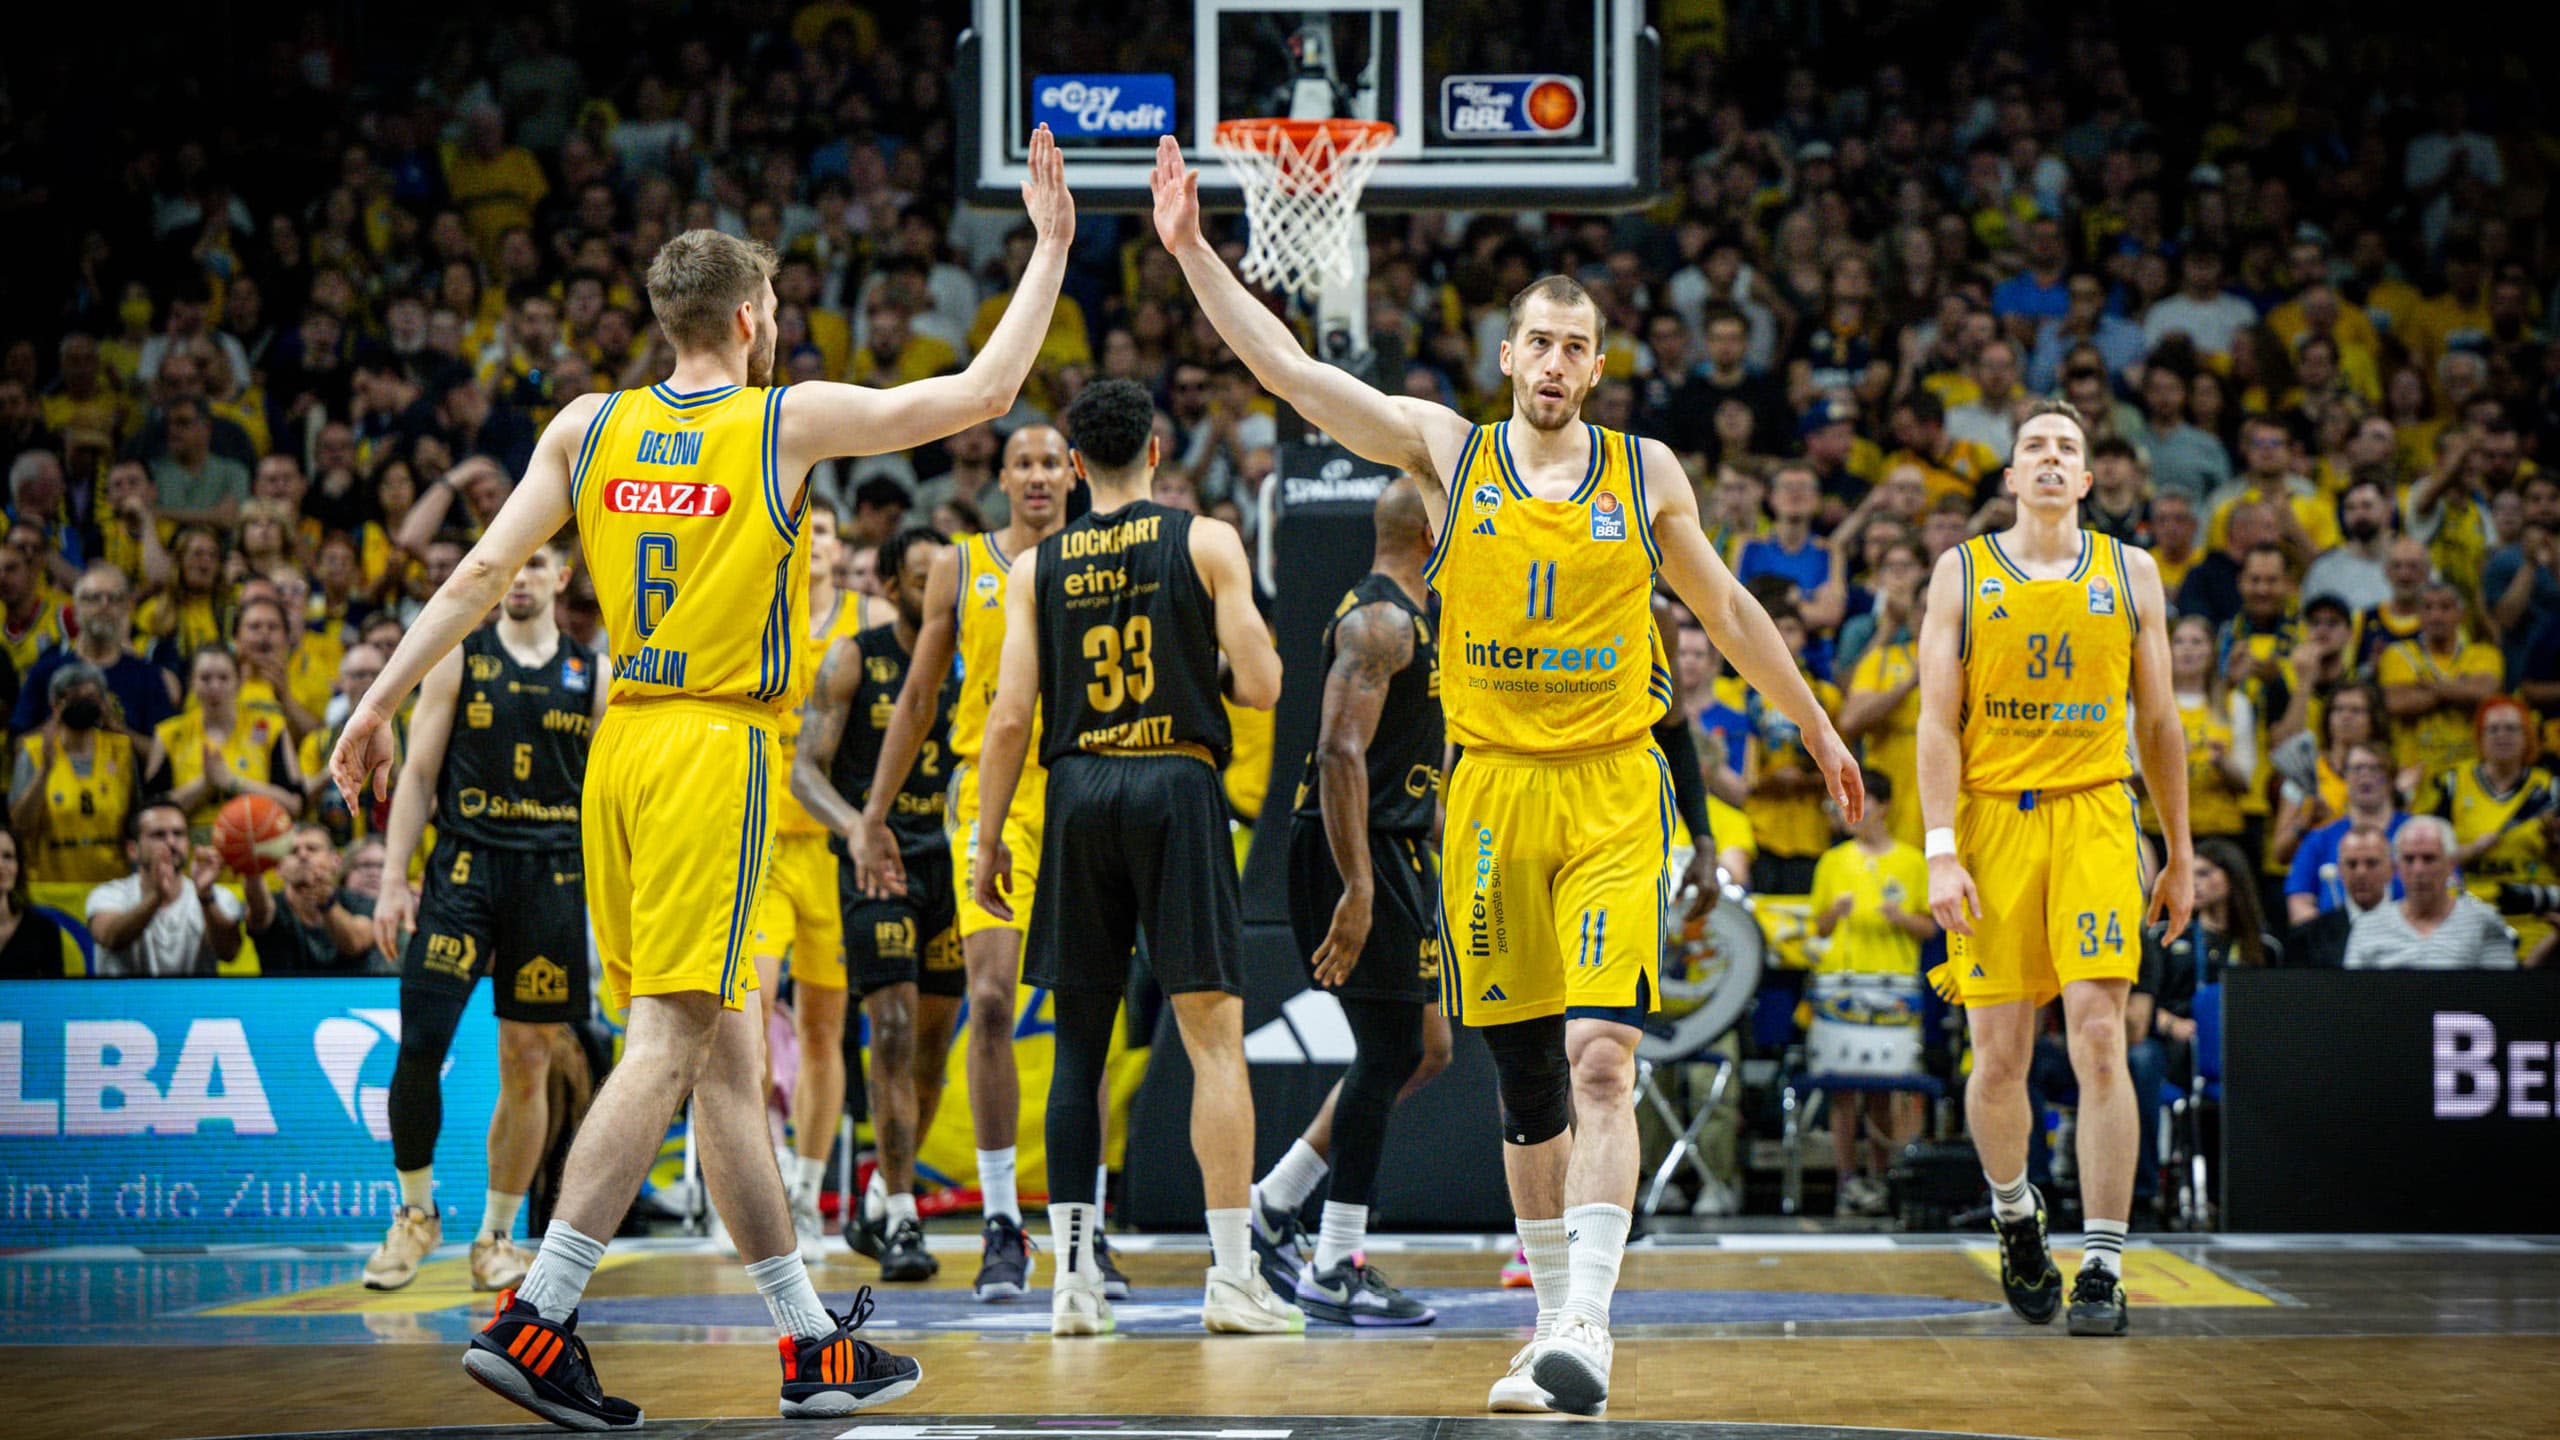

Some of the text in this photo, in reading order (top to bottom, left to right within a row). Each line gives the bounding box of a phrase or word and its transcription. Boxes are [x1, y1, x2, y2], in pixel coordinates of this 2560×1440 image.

[1078, 104, 1167, 130] Credit
[1454, 105, 1514, 131] BBL
[636, 429, 704, 465] DELOW
[1595, 525, 1622, 537] BBL
[634, 532, 678, 640] 6
[1064, 563, 1127, 596] eins
[1527, 560, 1557, 620] 11
[1082, 615, 1154, 713] 33
[1465, 630, 1618, 671] interzero
[2028, 632, 2074, 679] 34
[1468, 676, 1617, 693] zero waste solutions
[1984, 692, 2107, 722] interzero
[514, 743, 533, 781] 5
[921, 740, 940, 776] 2
[450, 851, 473, 884] 5
[1466, 828, 1493, 957] interzero
[1492, 891, 1505, 926] waste
[1496, 927, 1509, 954] zero
[1579, 908, 1607, 967] 11
[2077, 910, 2124, 957] 34
[0, 1017, 278, 1135] LBA
[2432, 1011, 2560, 1119] BE
[115, 1173, 200, 1219] die
